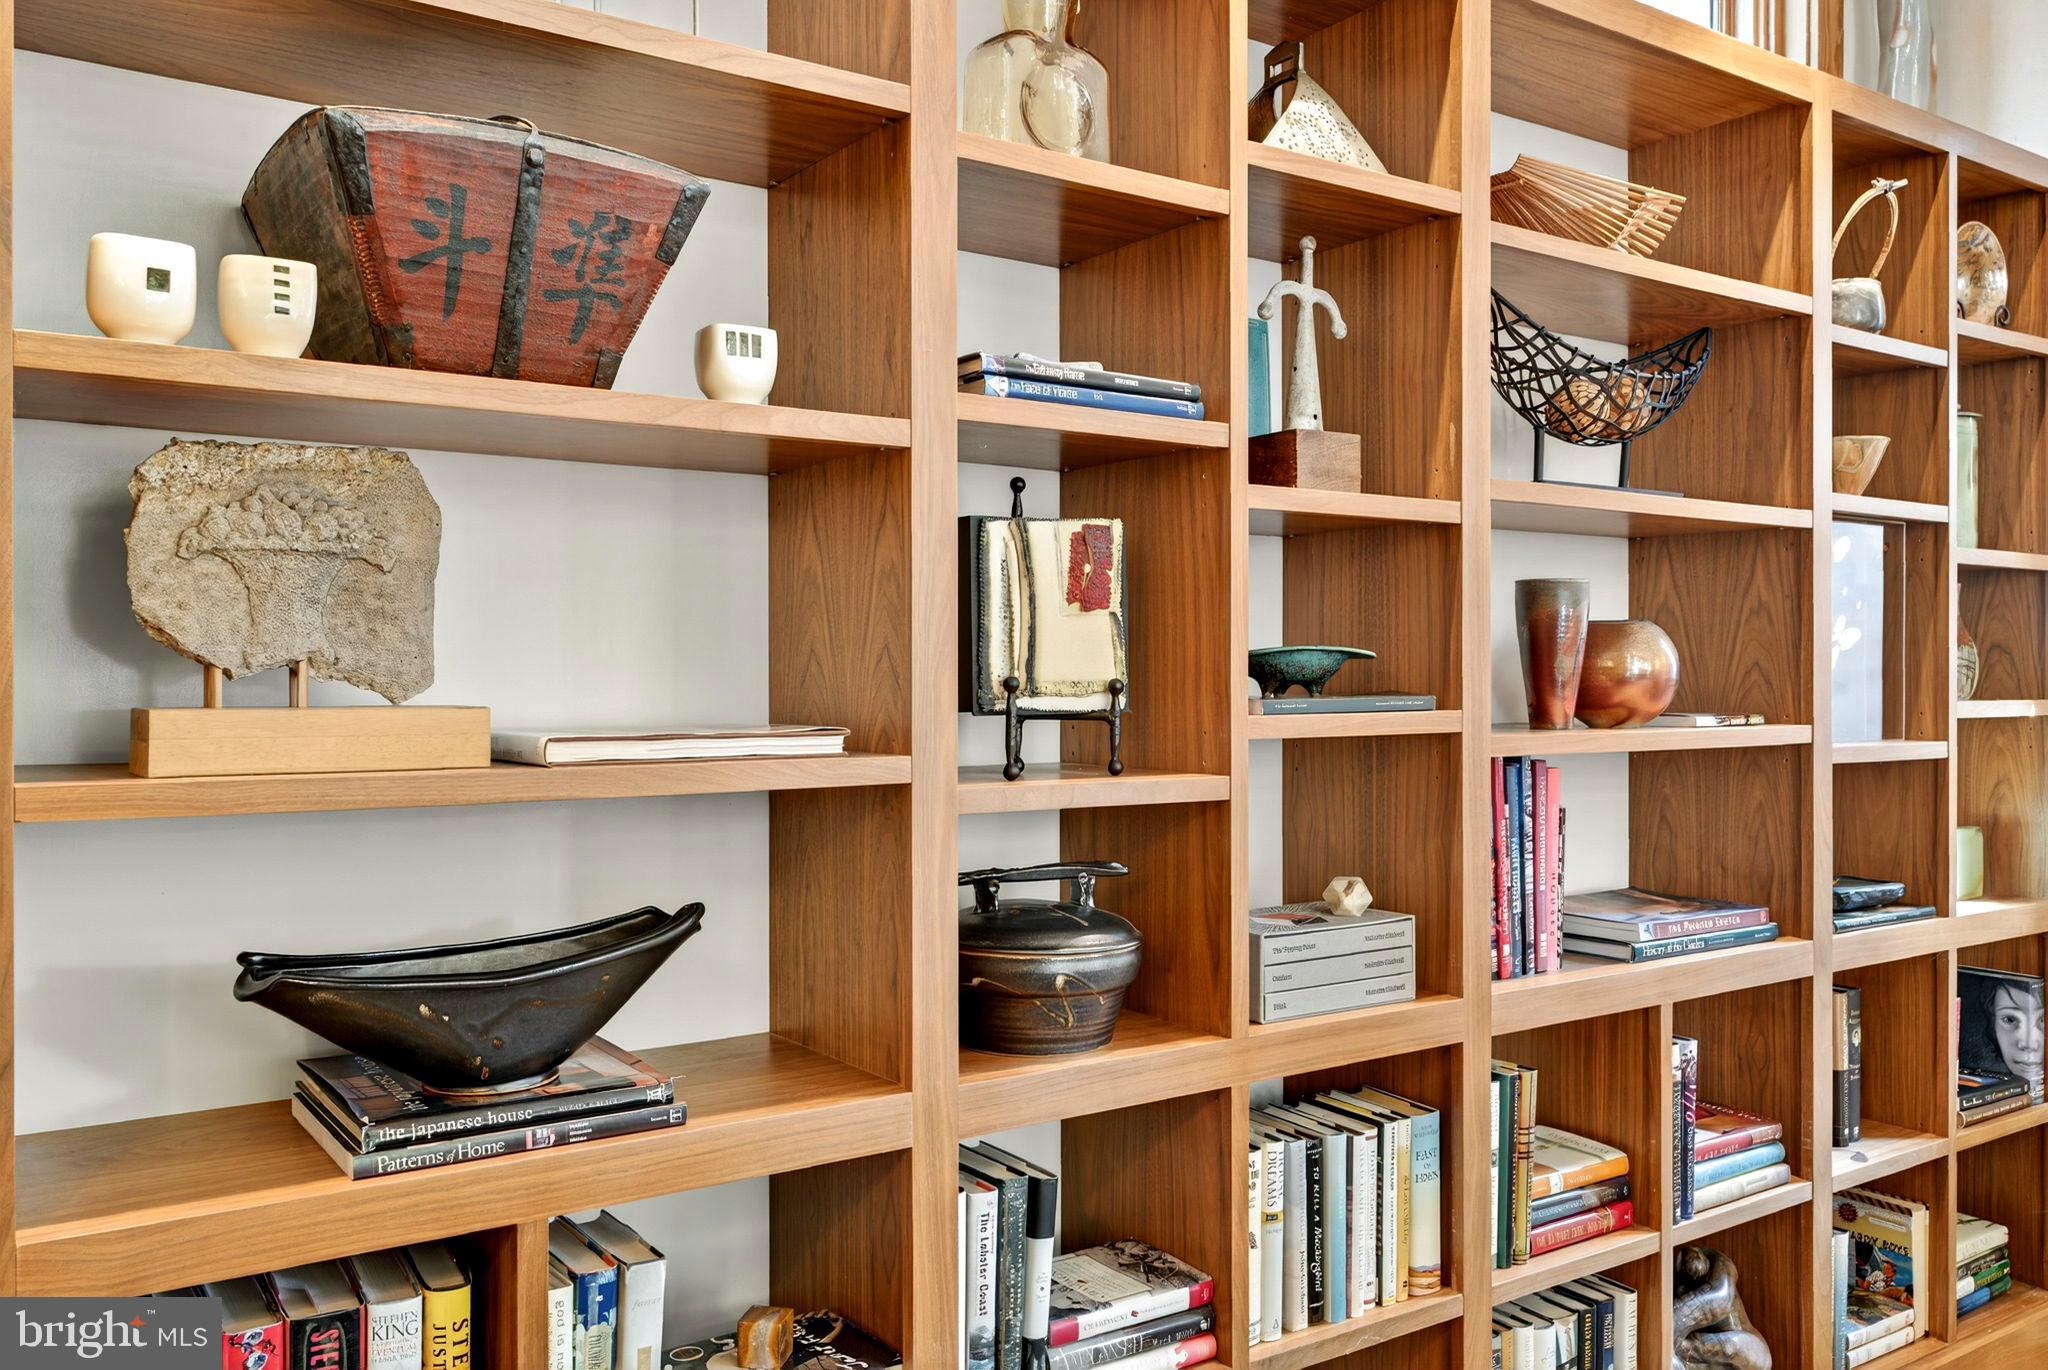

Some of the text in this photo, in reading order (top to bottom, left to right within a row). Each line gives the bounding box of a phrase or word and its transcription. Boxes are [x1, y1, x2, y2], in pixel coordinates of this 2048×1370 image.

[398, 183, 492, 321] 斗
[1684, 1084, 1697, 1127] 1776
[380, 1109, 533, 1142] the japanese house
[377, 1140, 506, 1174] Patterns of Home
[1313, 1166, 1320, 1180] TO
[1266, 1151, 1278, 1209] DREAMS
[1313, 1214, 1320, 1222] A
[978, 1212, 990, 1318] The Lobster Coast
[1310, 1227, 1323, 1292] Mockingbird
[371, 1311, 418, 1325] STEPHEN
[372, 1319, 419, 1341] KING
[555, 1300, 565, 1328] god
[557, 1332, 566, 1346] is
